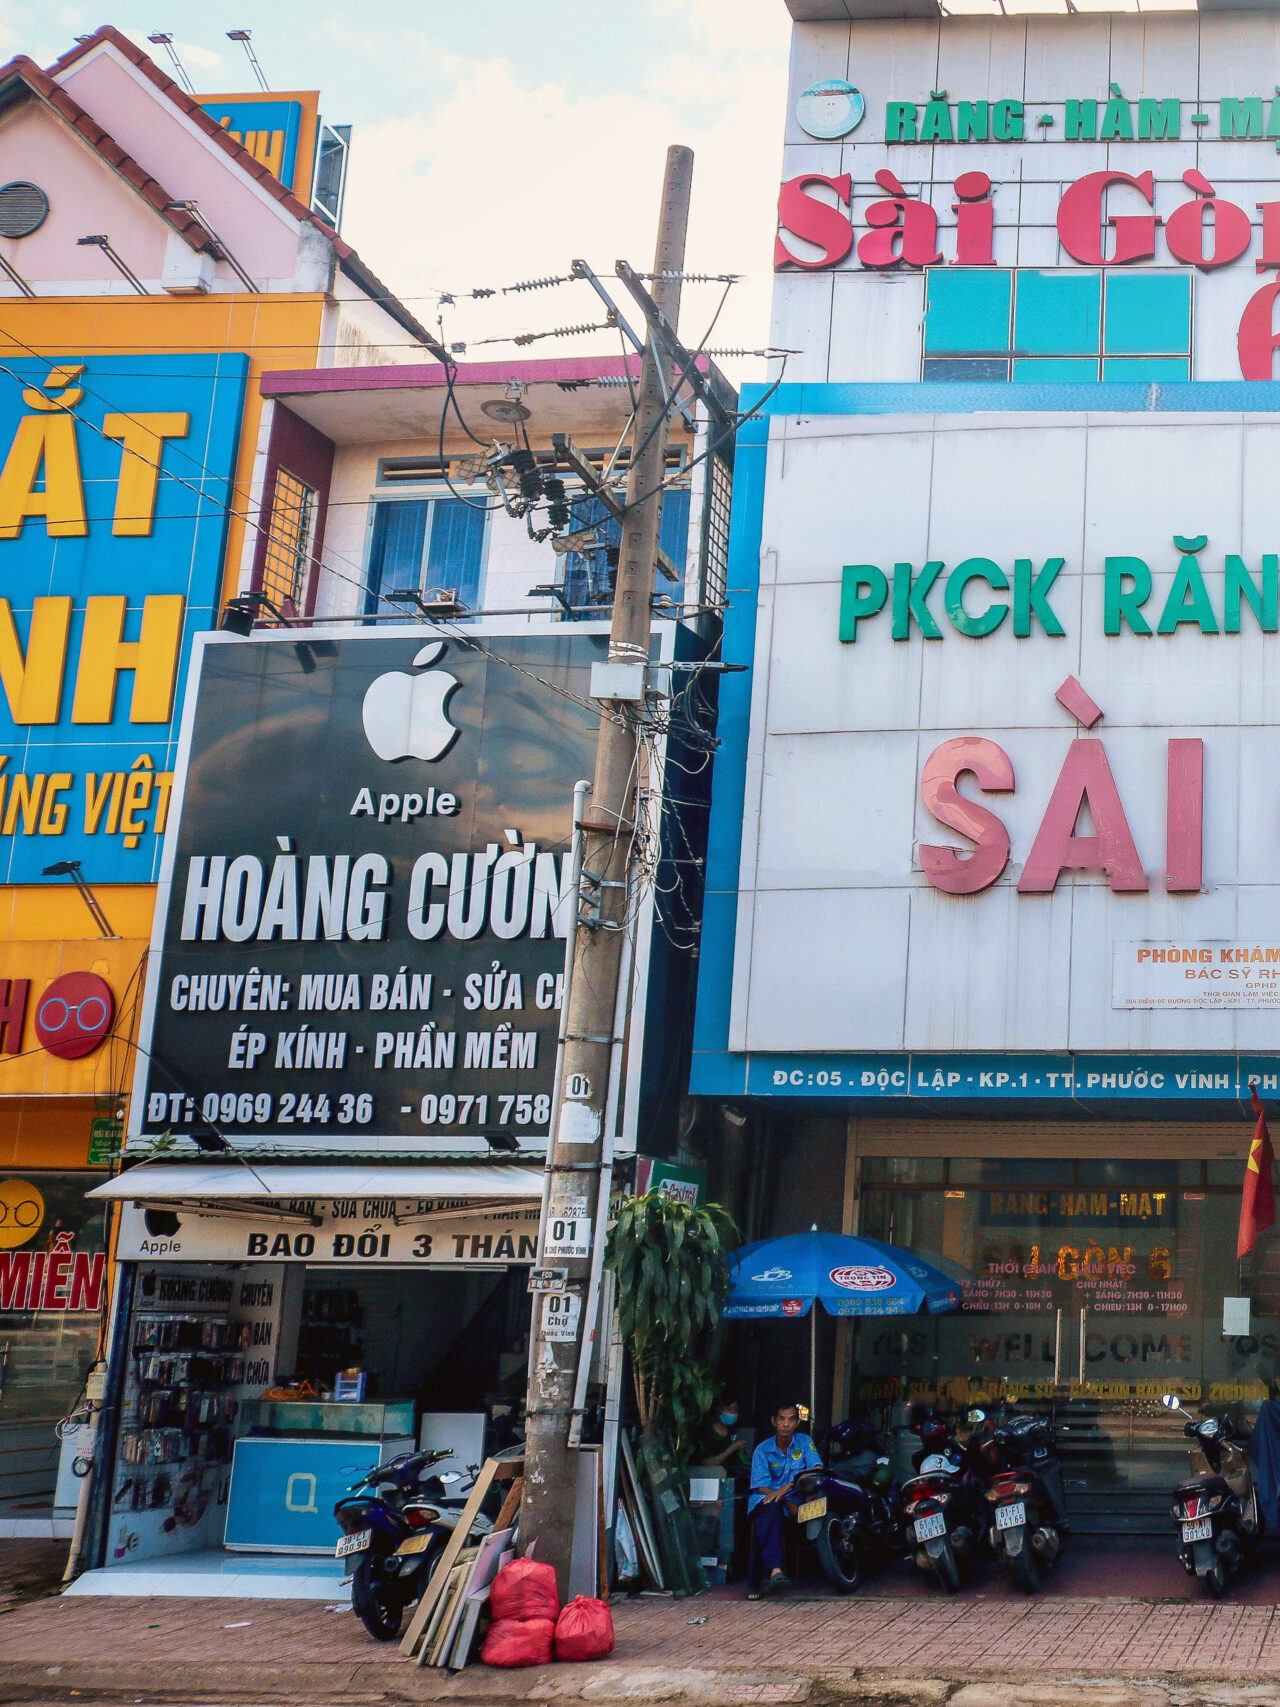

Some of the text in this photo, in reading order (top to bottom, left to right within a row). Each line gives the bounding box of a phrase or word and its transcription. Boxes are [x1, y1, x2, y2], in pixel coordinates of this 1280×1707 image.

[885, 89, 1025, 145] RĂNG
[1065, 82, 1181, 142] HÀM
[774, 168, 998, 272] Sài
[838, 557, 1066, 644] PKCK
[918, 674, 1209, 895] SÀI
[350, 787, 461, 822] Apple
[180, 830, 575, 942] HOÀNG CƯỜN
[1137, 945, 1213, 963] PHÒNG
[170, 966, 291, 1012] CHUYÊN:
[298, 974, 362, 1011] MUA
[370, 966, 434, 1011] BÁN
[463, 961, 524, 1011] SỬA
[1184, 967, 1222, 979] BÁC
[228, 1022, 539, 1069] ÉP KÍNH PHẦN MỀM
[571, 1075, 590, 1097] 01
[861, 1068, 906, 1091] ĐỘC
[917, 1068, 961, 1091] LẬP
[1086, 1067, 1165, 1089] PHƯỚC
[148, 1092, 195, 1124] ĐT:
[203, 1093, 271, 1124] 0969
[278, 1093, 332, 1124] 244
[338, 1093, 375, 1124] 36
[420, 1094, 487, 1125] 0971
[139, 1223, 539, 1260] Apple BAO ĐỔI 3 THÁN
[553, 1220, 577, 1241] 01
[0, 1231, 105, 1311] MIỄN
[1148, 1246, 1172, 1280] 6
[549, 1295, 571, 1313] 01
